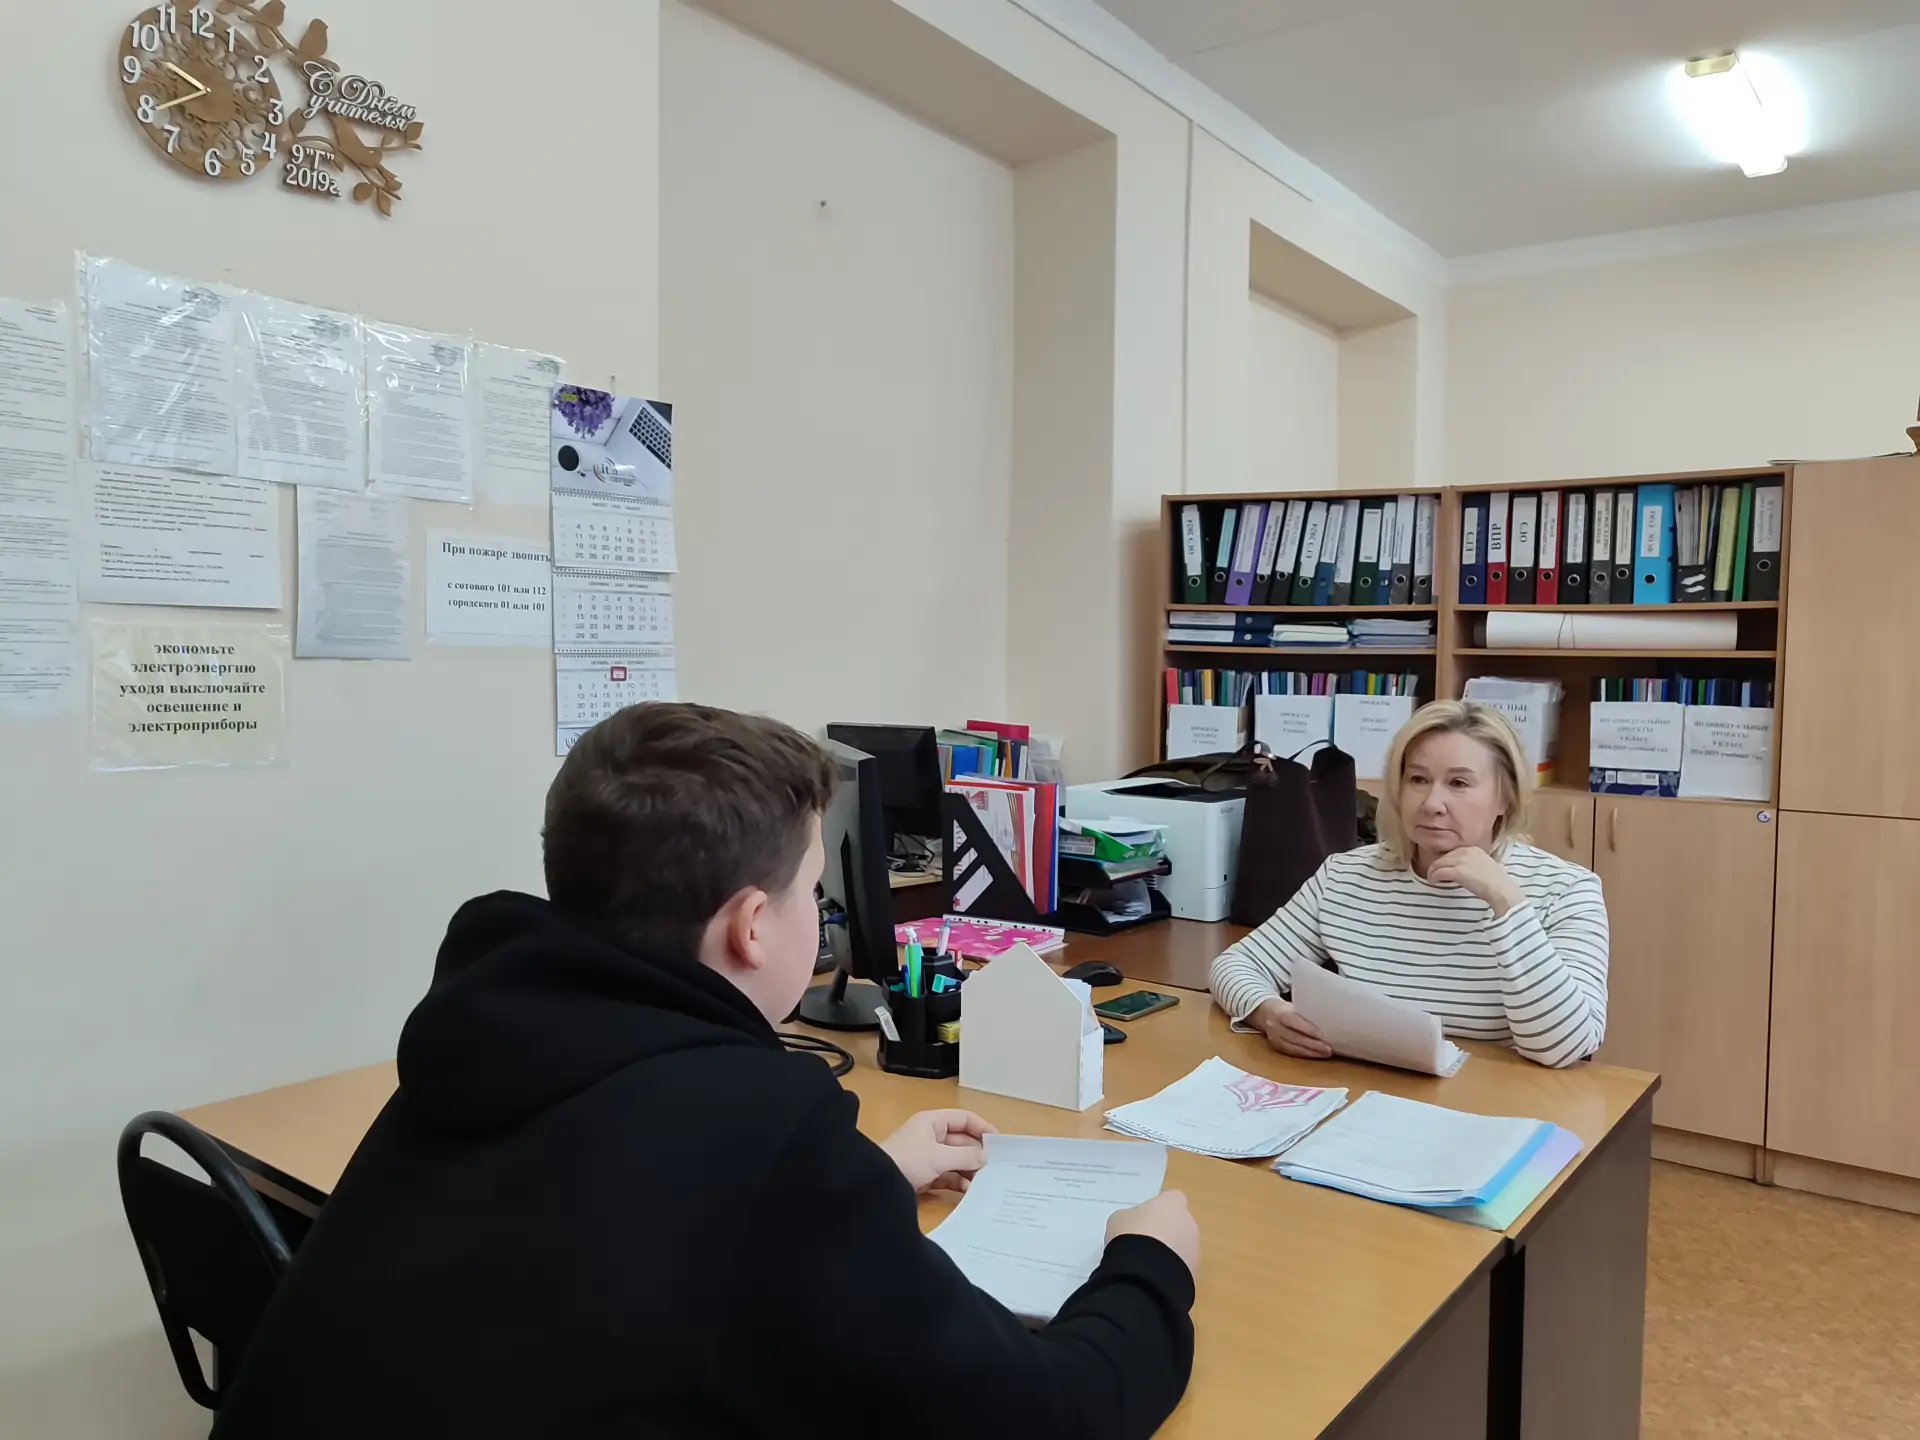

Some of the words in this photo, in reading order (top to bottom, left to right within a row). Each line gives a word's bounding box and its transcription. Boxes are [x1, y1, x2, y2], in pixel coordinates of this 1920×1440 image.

[156, 4, 177, 34] 11
[189, 7, 214, 39] 12
[130, 21, 159, 52] 10
[226, 26, 236, 53] 1
[122, 55, 141, 84] 9
[254, 55, 270, 83] 2
[302, 60, 337, 96] С
[339, 74, 418, 120] Днём
[137, 95, 157, 124] 8
[268, 98, 284, 126] 3
[302, 94, 410, 131] учителя
[163, 124, 181, 153] 7
[261, 132, 276, 160] 4
[204, 149, 221, 176] 6
[240, 148, 256, 176] 5
[286, 164, 342, 197] 2019г.
[1490, 522, 1502, 550] ВПР
[442, 542, 466, 556] При
[468, 546, 508, 559] пожаре
[454, 582, 495, 592] сотового
[498, 584, 511, 593] 101
[513, 587, 530, 595] или
[532, 586, 546, 596] 112
[448, 600, 499, 609] городского
[500, 600, 511, 610] 01
[532, 602, 546, 612] 101
[154, 644, 235, 655] экономьте
[130, 662, 256, 676] электроэнергию
[120, 684, 164, 697] уходя
[170, 682, 266, 694] выключайте
[146, 702, 230, 714] освещение
[233, 702, 242, 712] и
[128, 718, 258, 734] электроприборы
